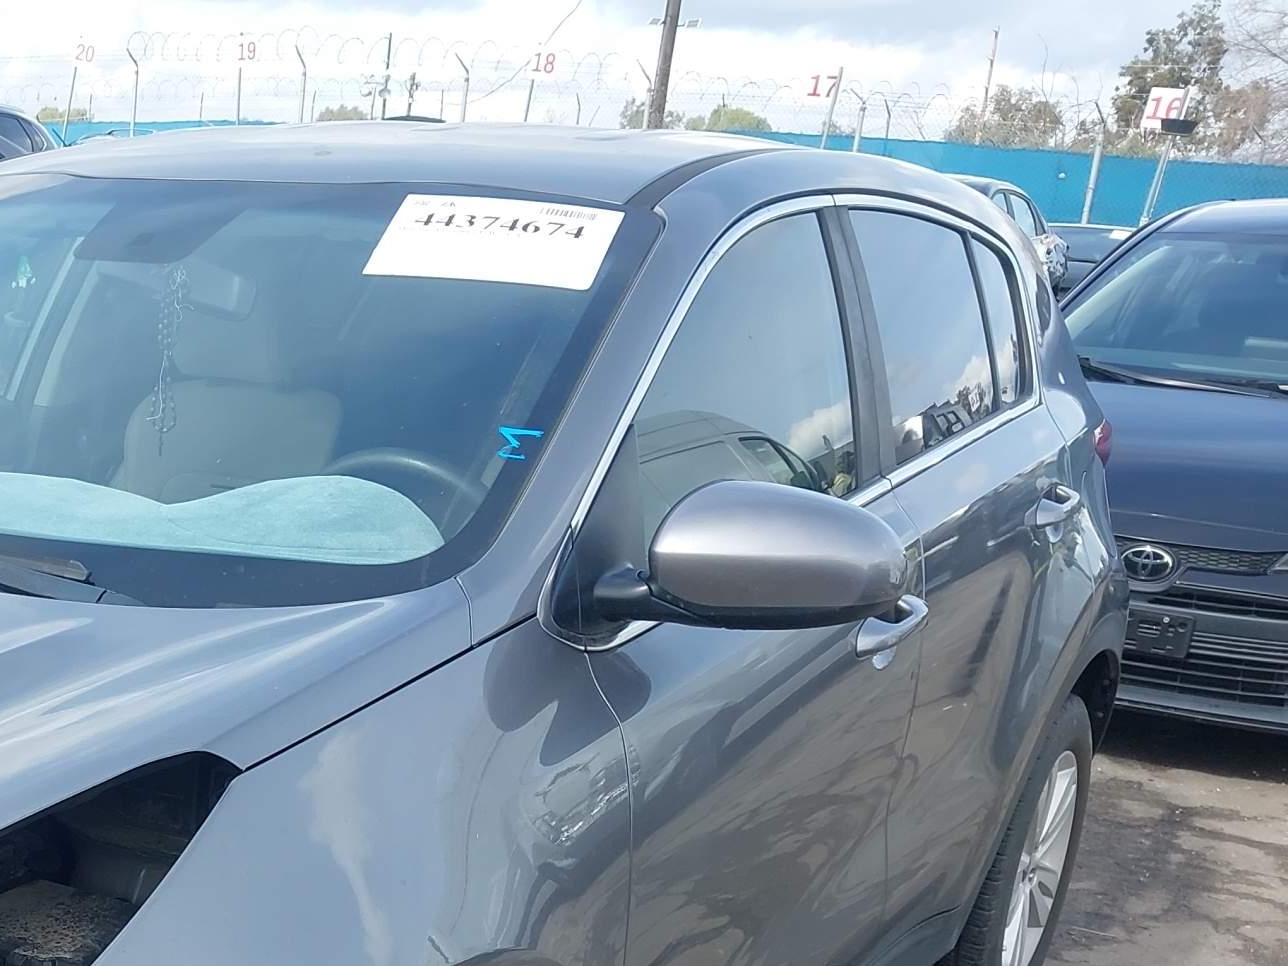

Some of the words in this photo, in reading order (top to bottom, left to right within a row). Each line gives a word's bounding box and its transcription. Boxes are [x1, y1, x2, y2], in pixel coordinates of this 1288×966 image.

[75, 43, 95, 63] 20
[237, 41, 256, 61] 19
[531, 52, 556, 74] 18
[807, 74, 839, 98] 17
[414, 212, 585, 239] 44374674
